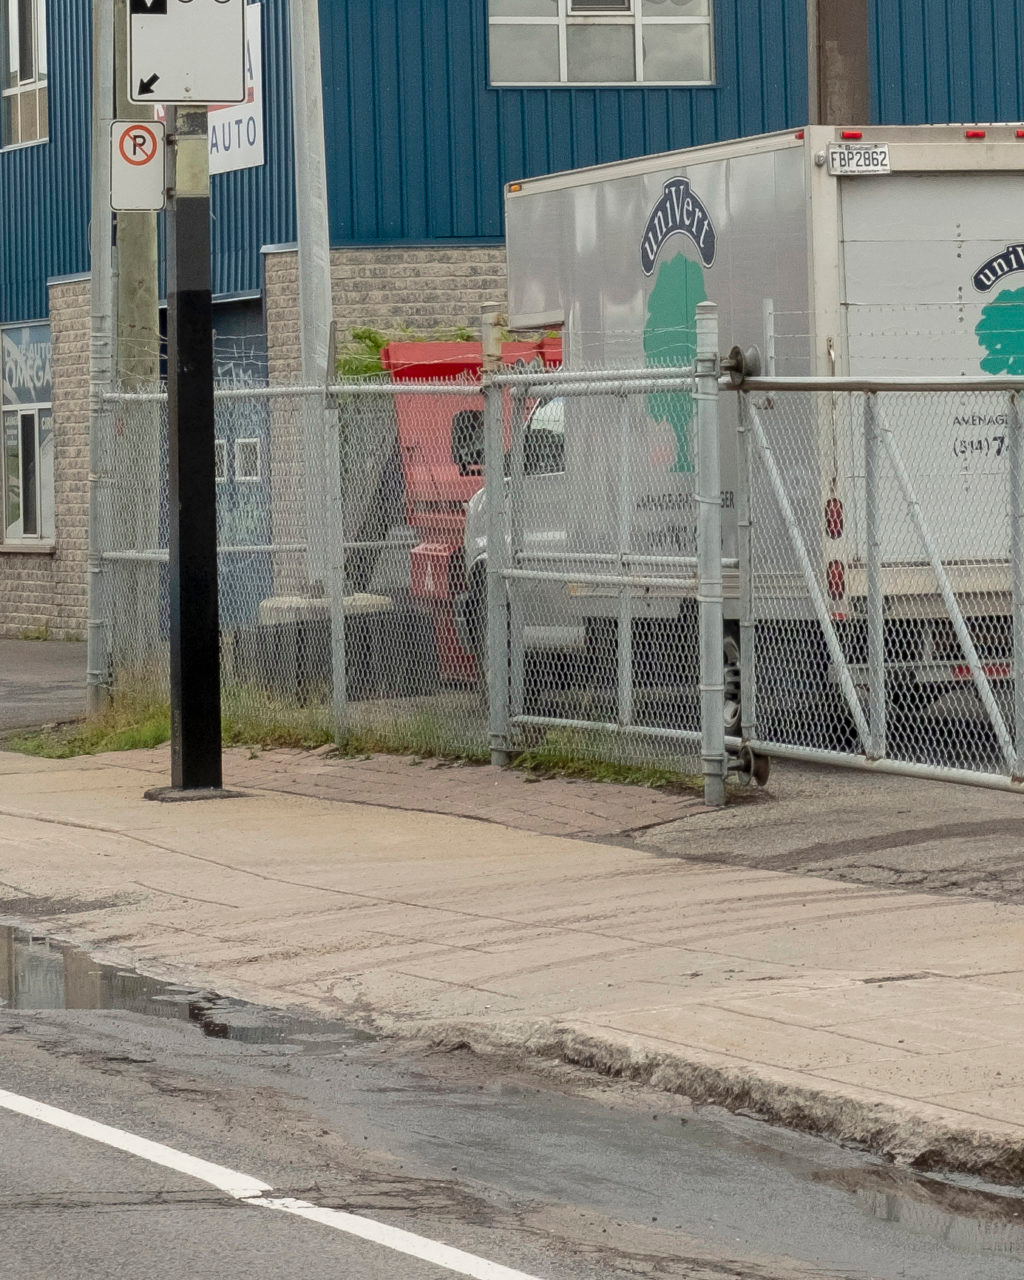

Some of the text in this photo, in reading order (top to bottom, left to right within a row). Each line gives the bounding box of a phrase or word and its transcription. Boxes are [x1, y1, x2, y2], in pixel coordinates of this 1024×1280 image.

[210, 116, 257, 155] AUTO
[831, 151, 889, 168] FBP2862
[644, 185, 709, 256] uniVert
